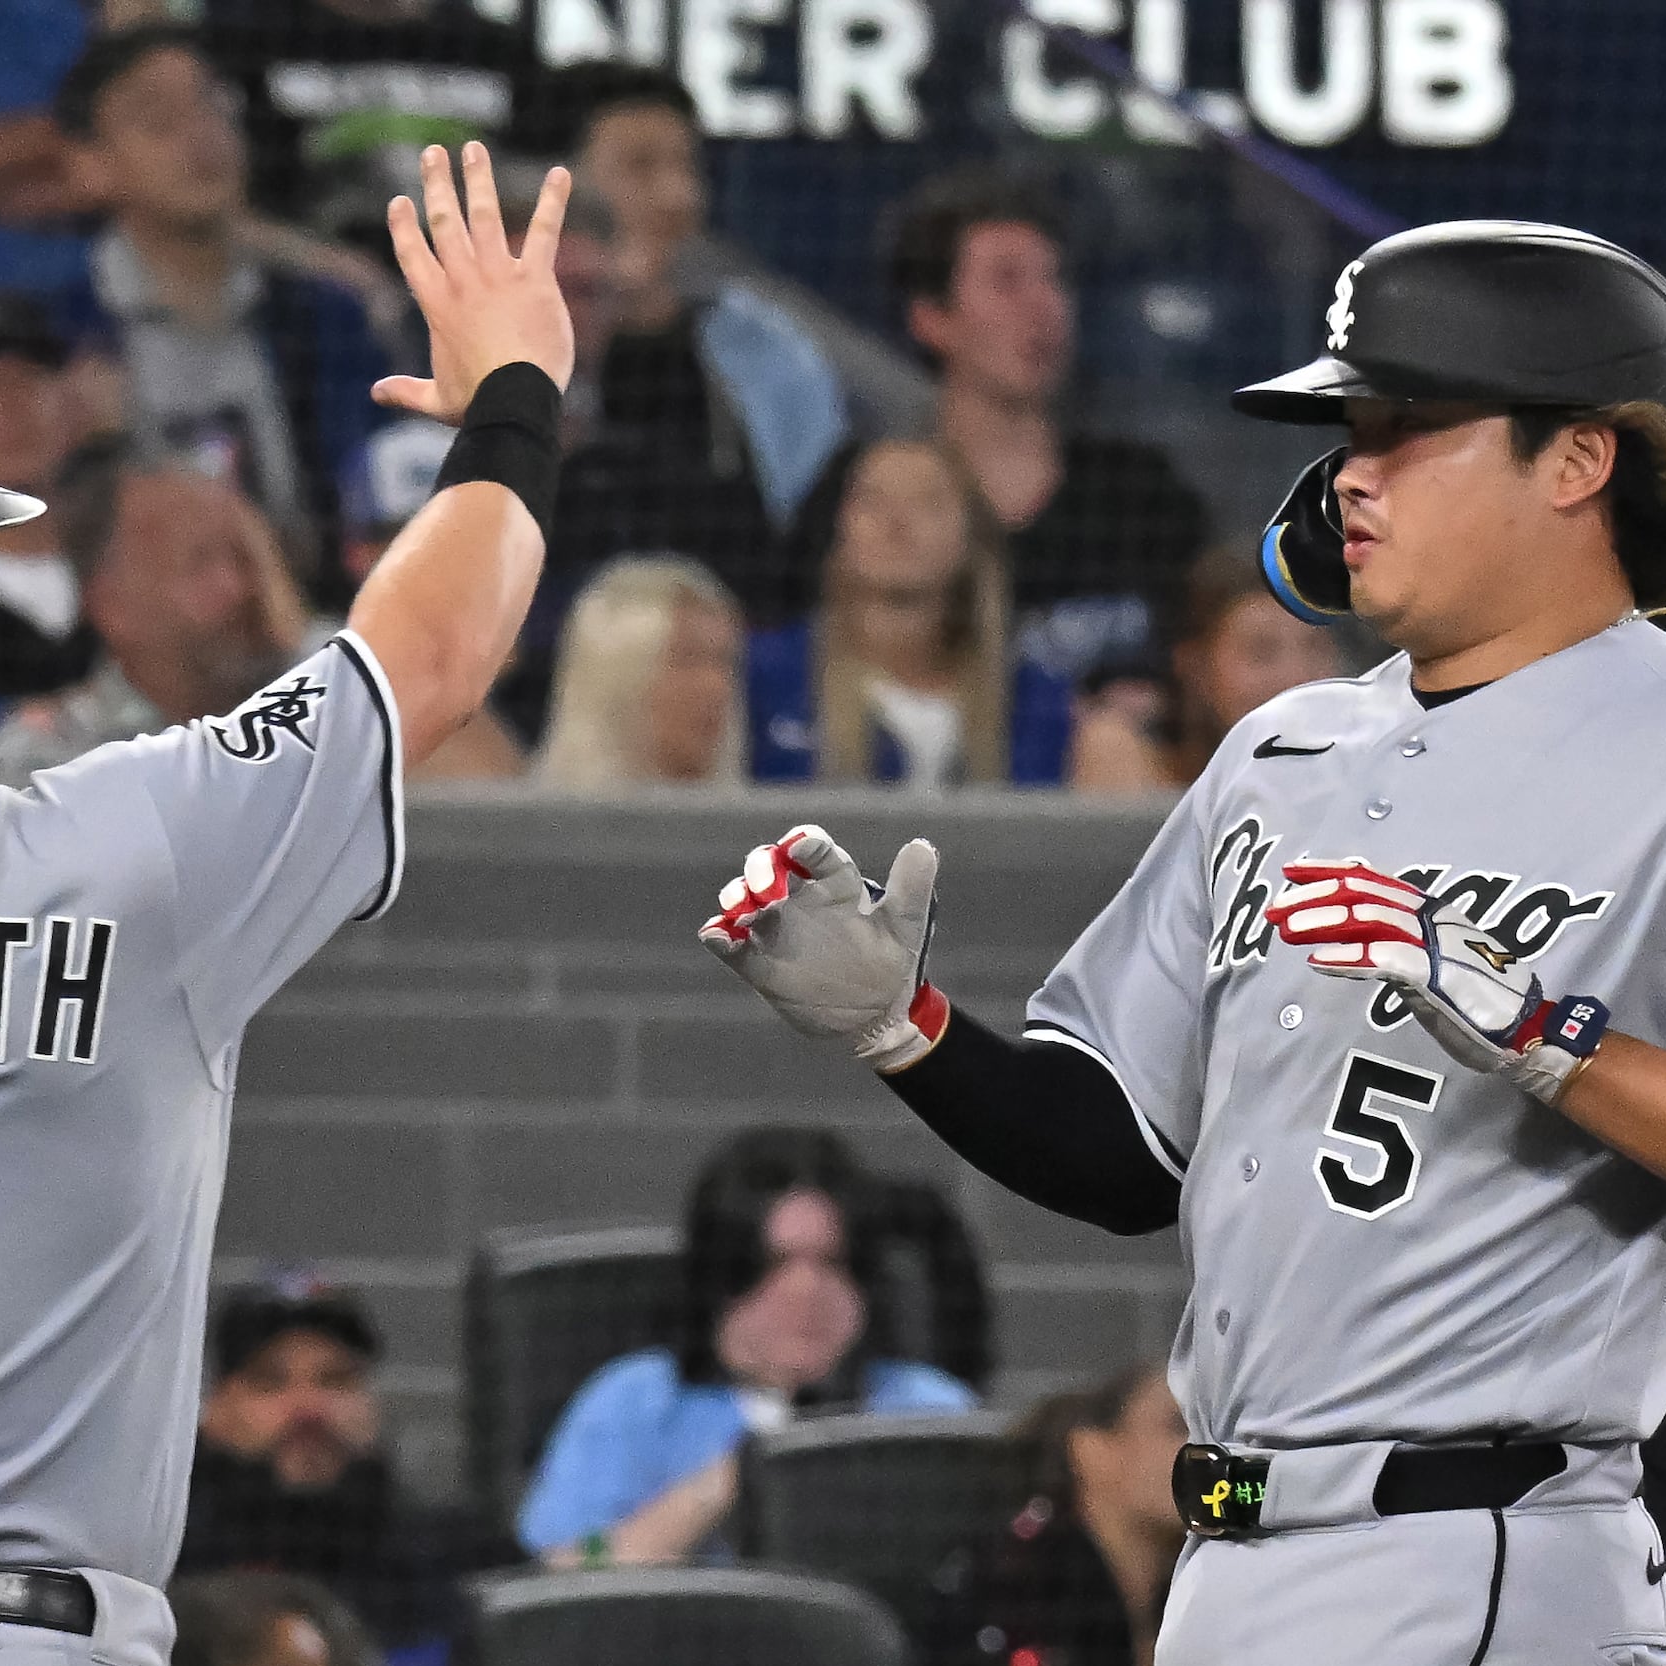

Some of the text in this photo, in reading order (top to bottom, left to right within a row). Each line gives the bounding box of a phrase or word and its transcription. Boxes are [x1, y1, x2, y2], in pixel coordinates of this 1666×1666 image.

[1001, 0, 1515, 147] CLUB
[1208, 813, 1616, 1033] Chgo
[1313, 1047, 1445, 1221] 5
